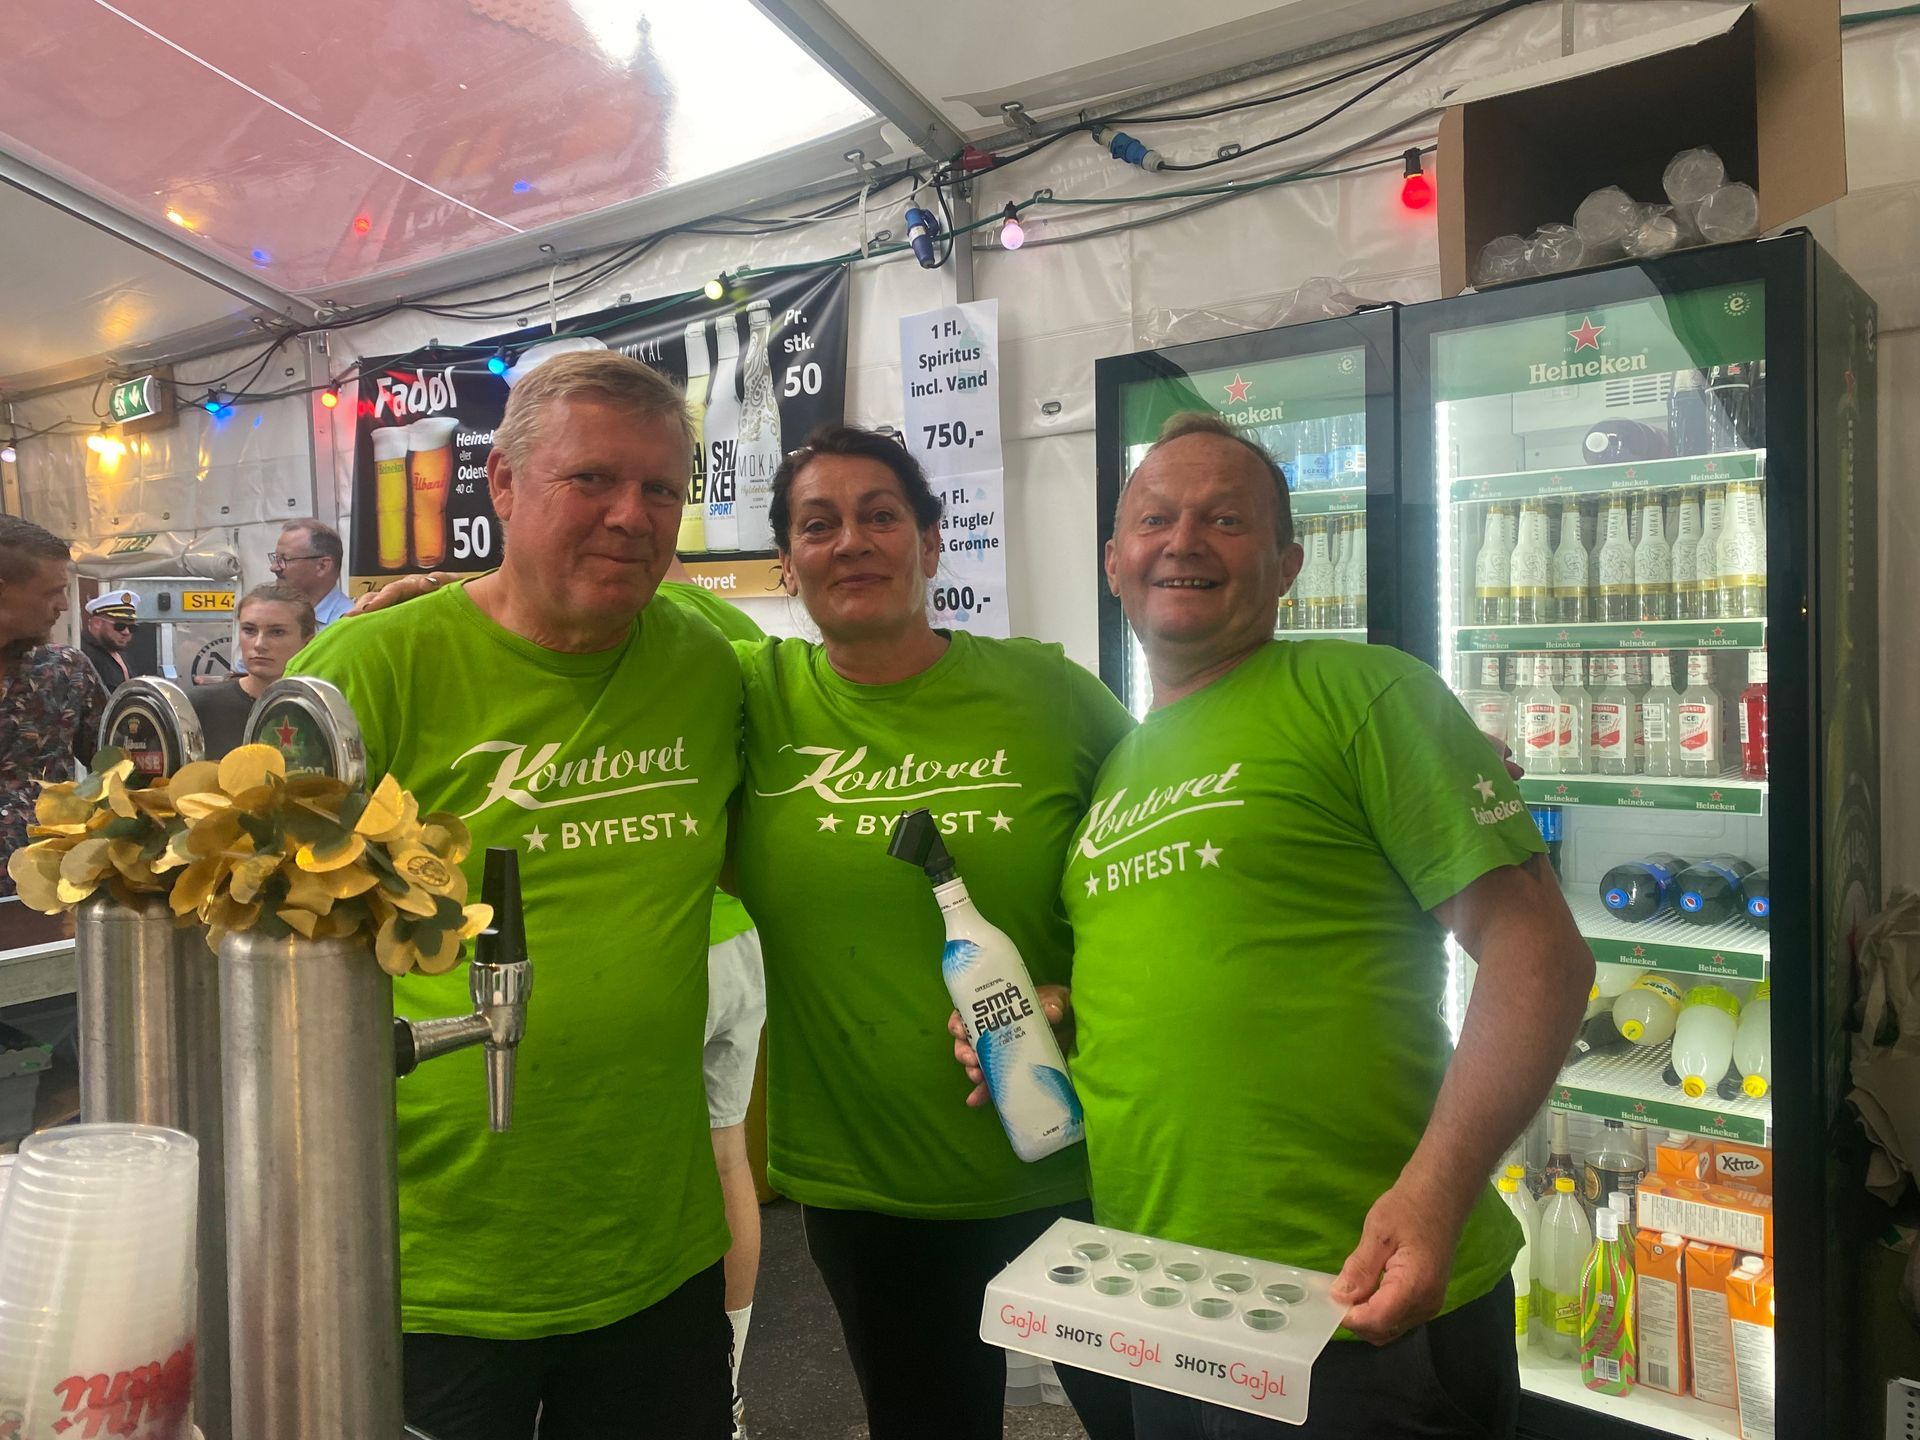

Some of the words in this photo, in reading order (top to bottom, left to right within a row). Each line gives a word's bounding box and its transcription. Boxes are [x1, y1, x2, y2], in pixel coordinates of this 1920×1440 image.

[784, 309, 807, 326] Pr.
[931, 324, 938, 340] 1
[944, 319, 962, 337] Fl.
[784, 332, 814, 353] stk.
[918, 346, 981, 370] Spiritus
[1529, 352, 1648, 385] Heineken
[784, 362, 822, 397] 50
[911, 381, 943, 398] incl.
[946, 370, 988, 393] Vand
[374, 366, 457, 418] Fadøl
[1213, 404, 1284, 427] ineken
[923, 420, 984, 450] 750,-
[459, 451, 472, 462] eller
[1611, 476, 1650, 488] Heineken
[1690, 471, 1731, 482] Heineken
[952, 488, 969, 504] Fl.
[710, 502, 733, 516] SPORT
[939, 515, 949, 530] å
[953, 512, 994, 531] Fugle/
[452, 515, 491, 559] 50
[949, 537, 999, 552] Grønne
[192, 594, 216, 608] SH
[933, 586, 991, 614] 600,-
[1545, 640, 1581, 649] Heineken
[1620, 638, 1657, 648] Heineken
[1698, 637, 1738, 647] Heineken
[451, 737, 698, 819] Kontoret
[755, 744, 1022, 804] Kontoret
[1544, 794, 1580, 804] Heineken
[1617, 797, 1656, 807] Heineken
[1696, 800, 1736, 811] Heineken
[856, 810, 981, 836] BYST
[1070, 762, 1244, 866] Kontoret
[561, 813, 676, 851] BYFEST
[1107, 841, 1191, 892] BYFEST
[1620, 955, 1657, 967] Heineken
[1698, 964, 1738, 976] Heineken
[972, 982, 1022, 1018] SMÅ
[974, 998, 1033, 1037] FUGLE
[1622, 1111, 1659, 1125] Heineken
[1700, 1125, 1739, 1139] Heineken
[1721, 1155, 1760, 1173] Xtra
[1055, 1323, 1103, 1347] SHOTS
[1175, 1353, 1227, 1379] SHOTS
